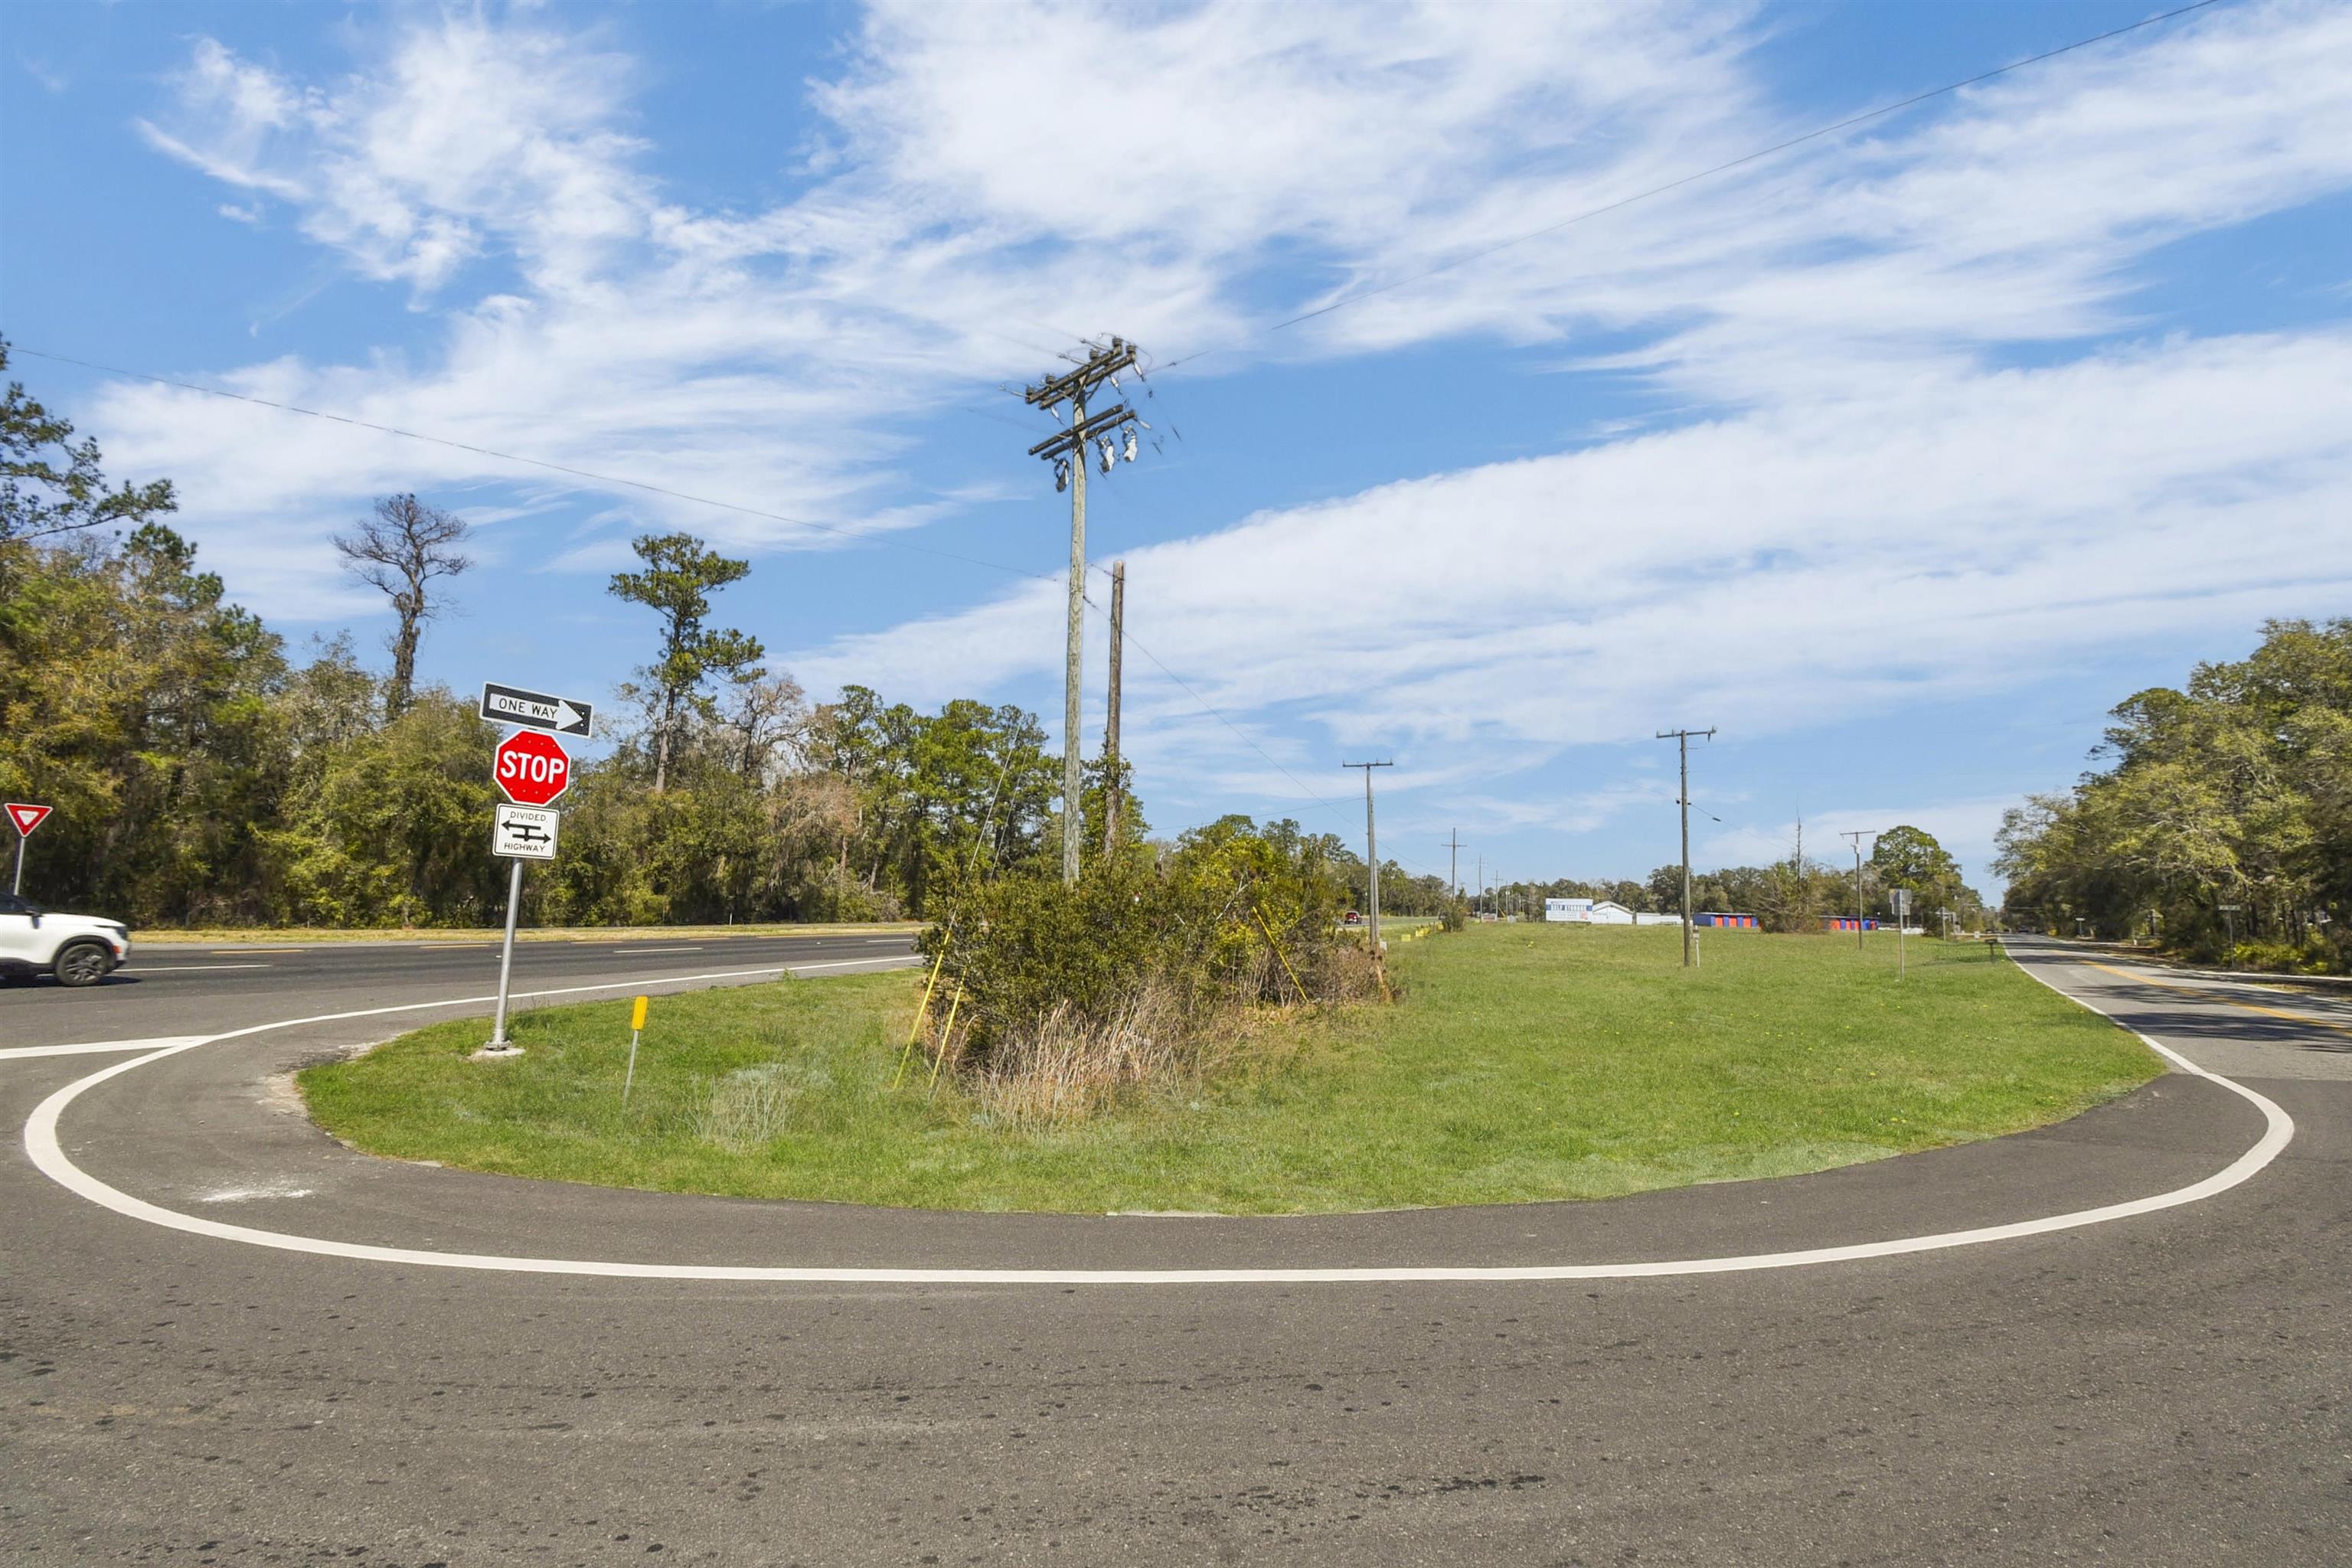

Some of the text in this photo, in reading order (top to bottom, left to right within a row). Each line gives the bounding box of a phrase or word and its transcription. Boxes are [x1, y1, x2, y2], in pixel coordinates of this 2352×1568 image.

[498, 697, 557, 719] ONE WAY
[501, 750, 564, 783] STOP
[510, 811, 547, 822] DIVIDED
[504, 842, 545, 852] HIGHWAY
